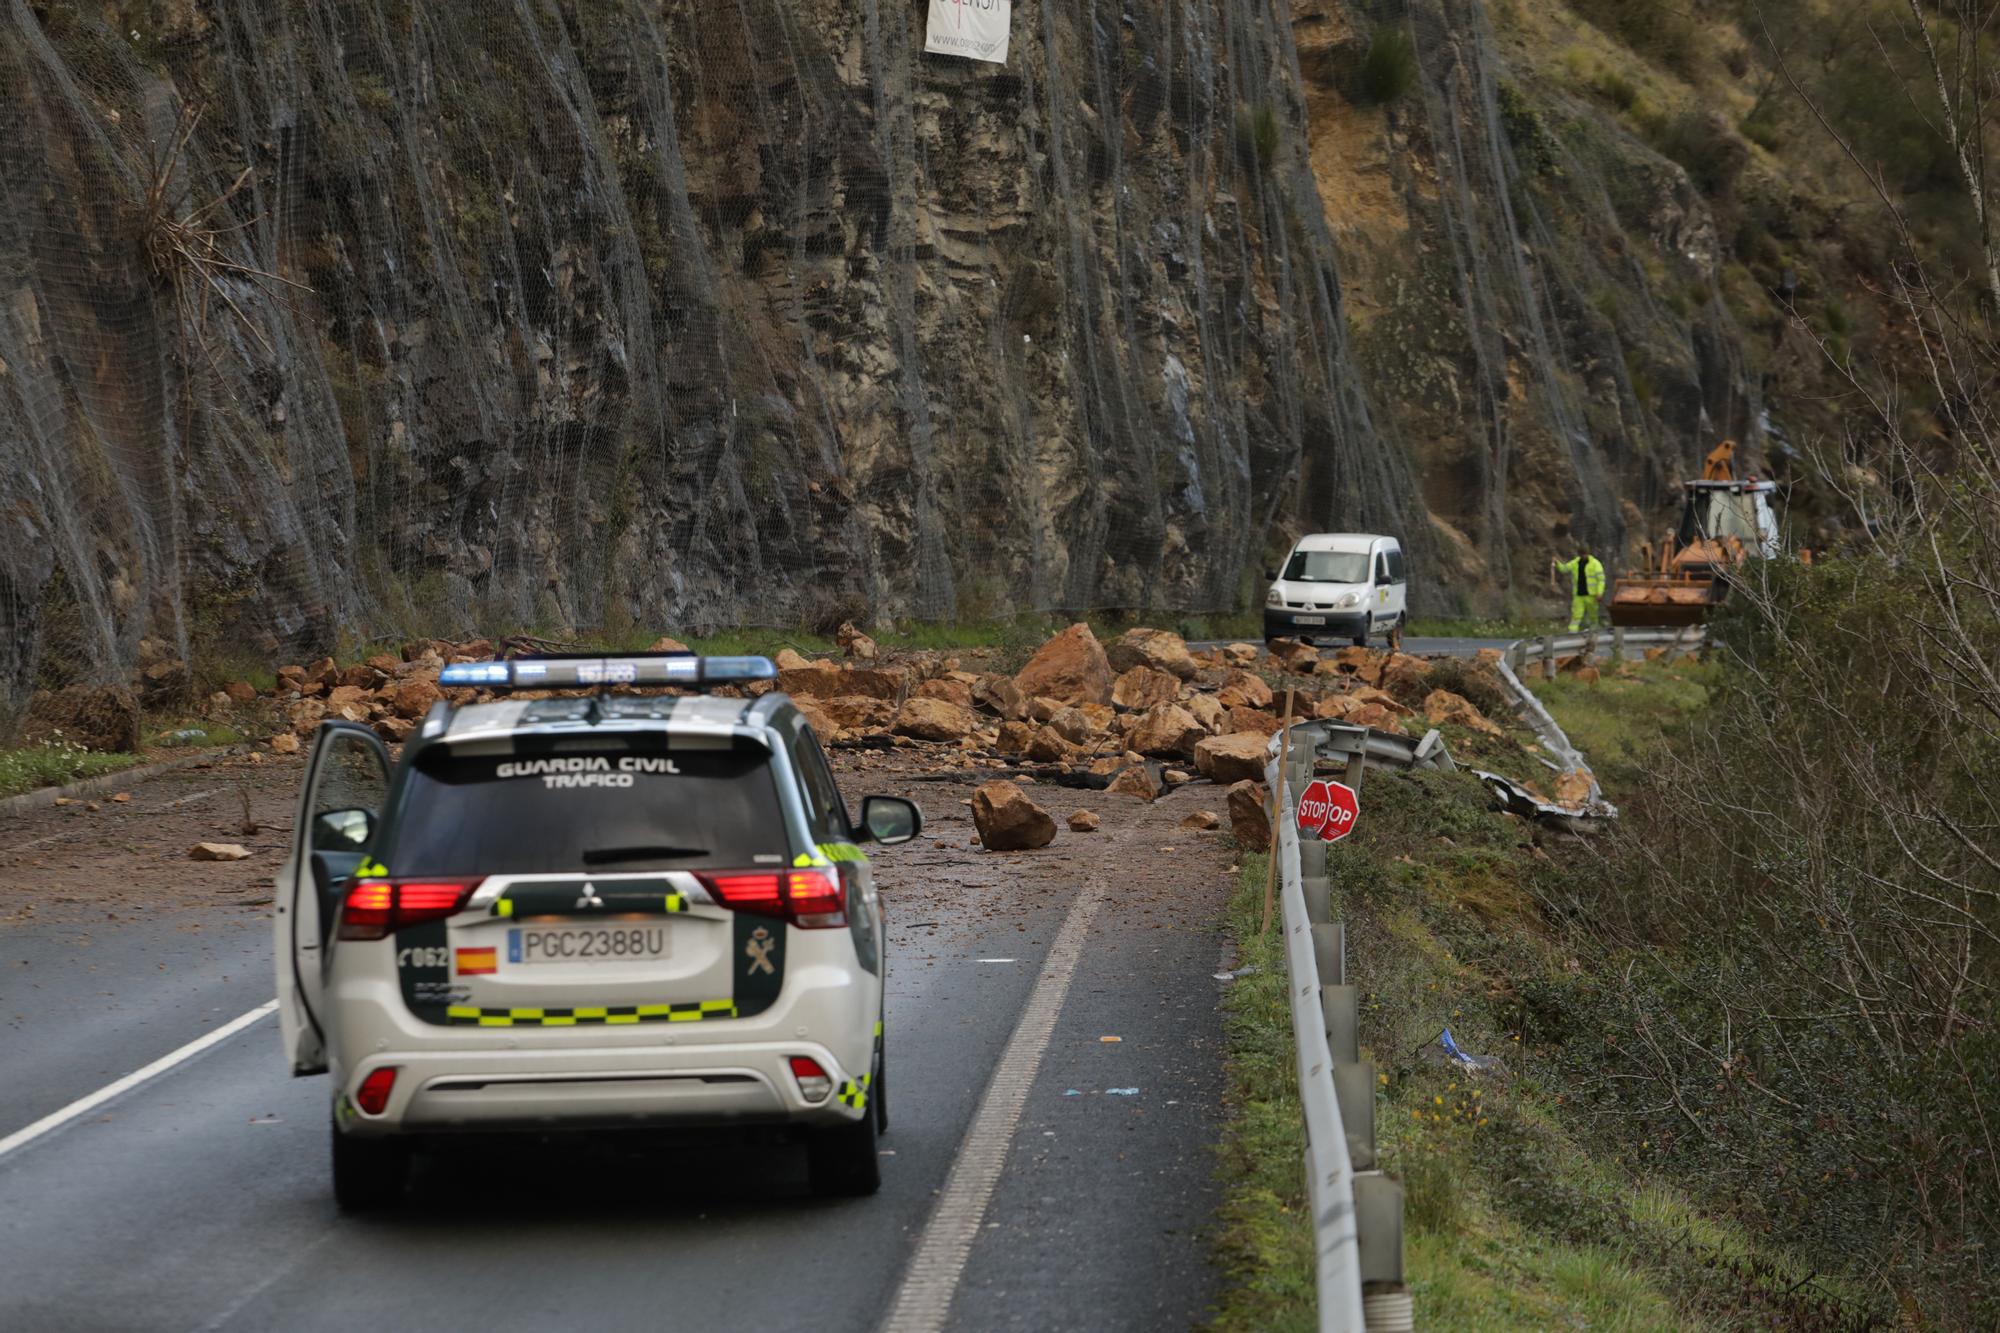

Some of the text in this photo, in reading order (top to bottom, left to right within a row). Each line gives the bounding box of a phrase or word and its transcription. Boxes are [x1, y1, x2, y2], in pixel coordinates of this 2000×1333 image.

[497, 757, 680, 777] GUARDIA CIVIL
[1301, 800, 1326, 818] STOP
[525, 930, 663, 958] PGC2388U
